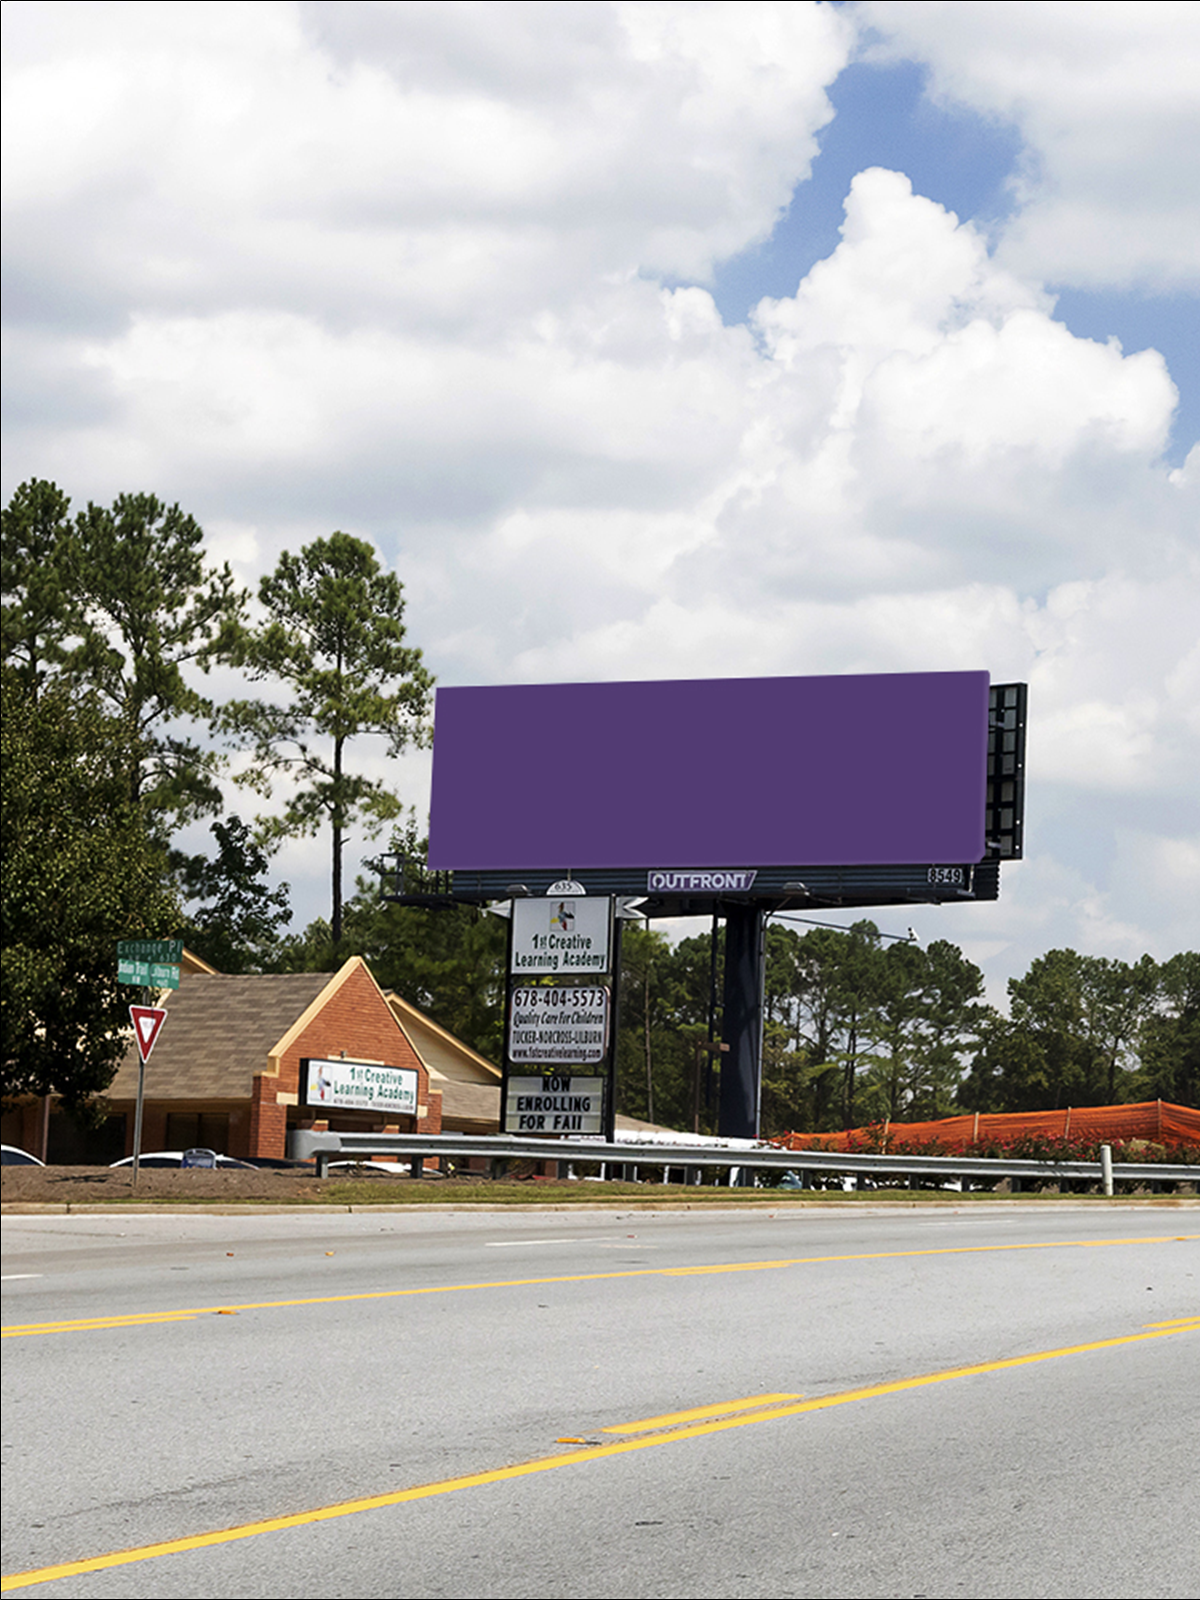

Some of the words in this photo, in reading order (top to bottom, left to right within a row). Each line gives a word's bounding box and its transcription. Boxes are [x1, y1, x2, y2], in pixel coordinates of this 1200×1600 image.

[652, 873, 746, 888] OUTFRONT
[928, 868, 962, 882] 8549
[554, 881, 572, 890] 635
[532, 933, 547, 949] 1st
[548, 934, 592, 949] Creative
[515, 952, 559, 970] Learning
[562, 951, 605, 969] Academy
[514, 990, 604, 1007] 678-404-5573
[513, 1010, 540, 1027] Quality
[540, 1011, 559, 1025] Care
[571, 1009, 603, 1025] Children
[349, 1067, 364, 1080] 1st
[364, 1068, 403, 1086] Creative
[542, 1077, 571, 1092] NOW
[333, 1080, 374, 1101] Learning
[377, 1085, 414, 1105] Academy
[517, 1096, 591, 1112] ENROLLING
[519, 1115, 545, 1130] FOR
